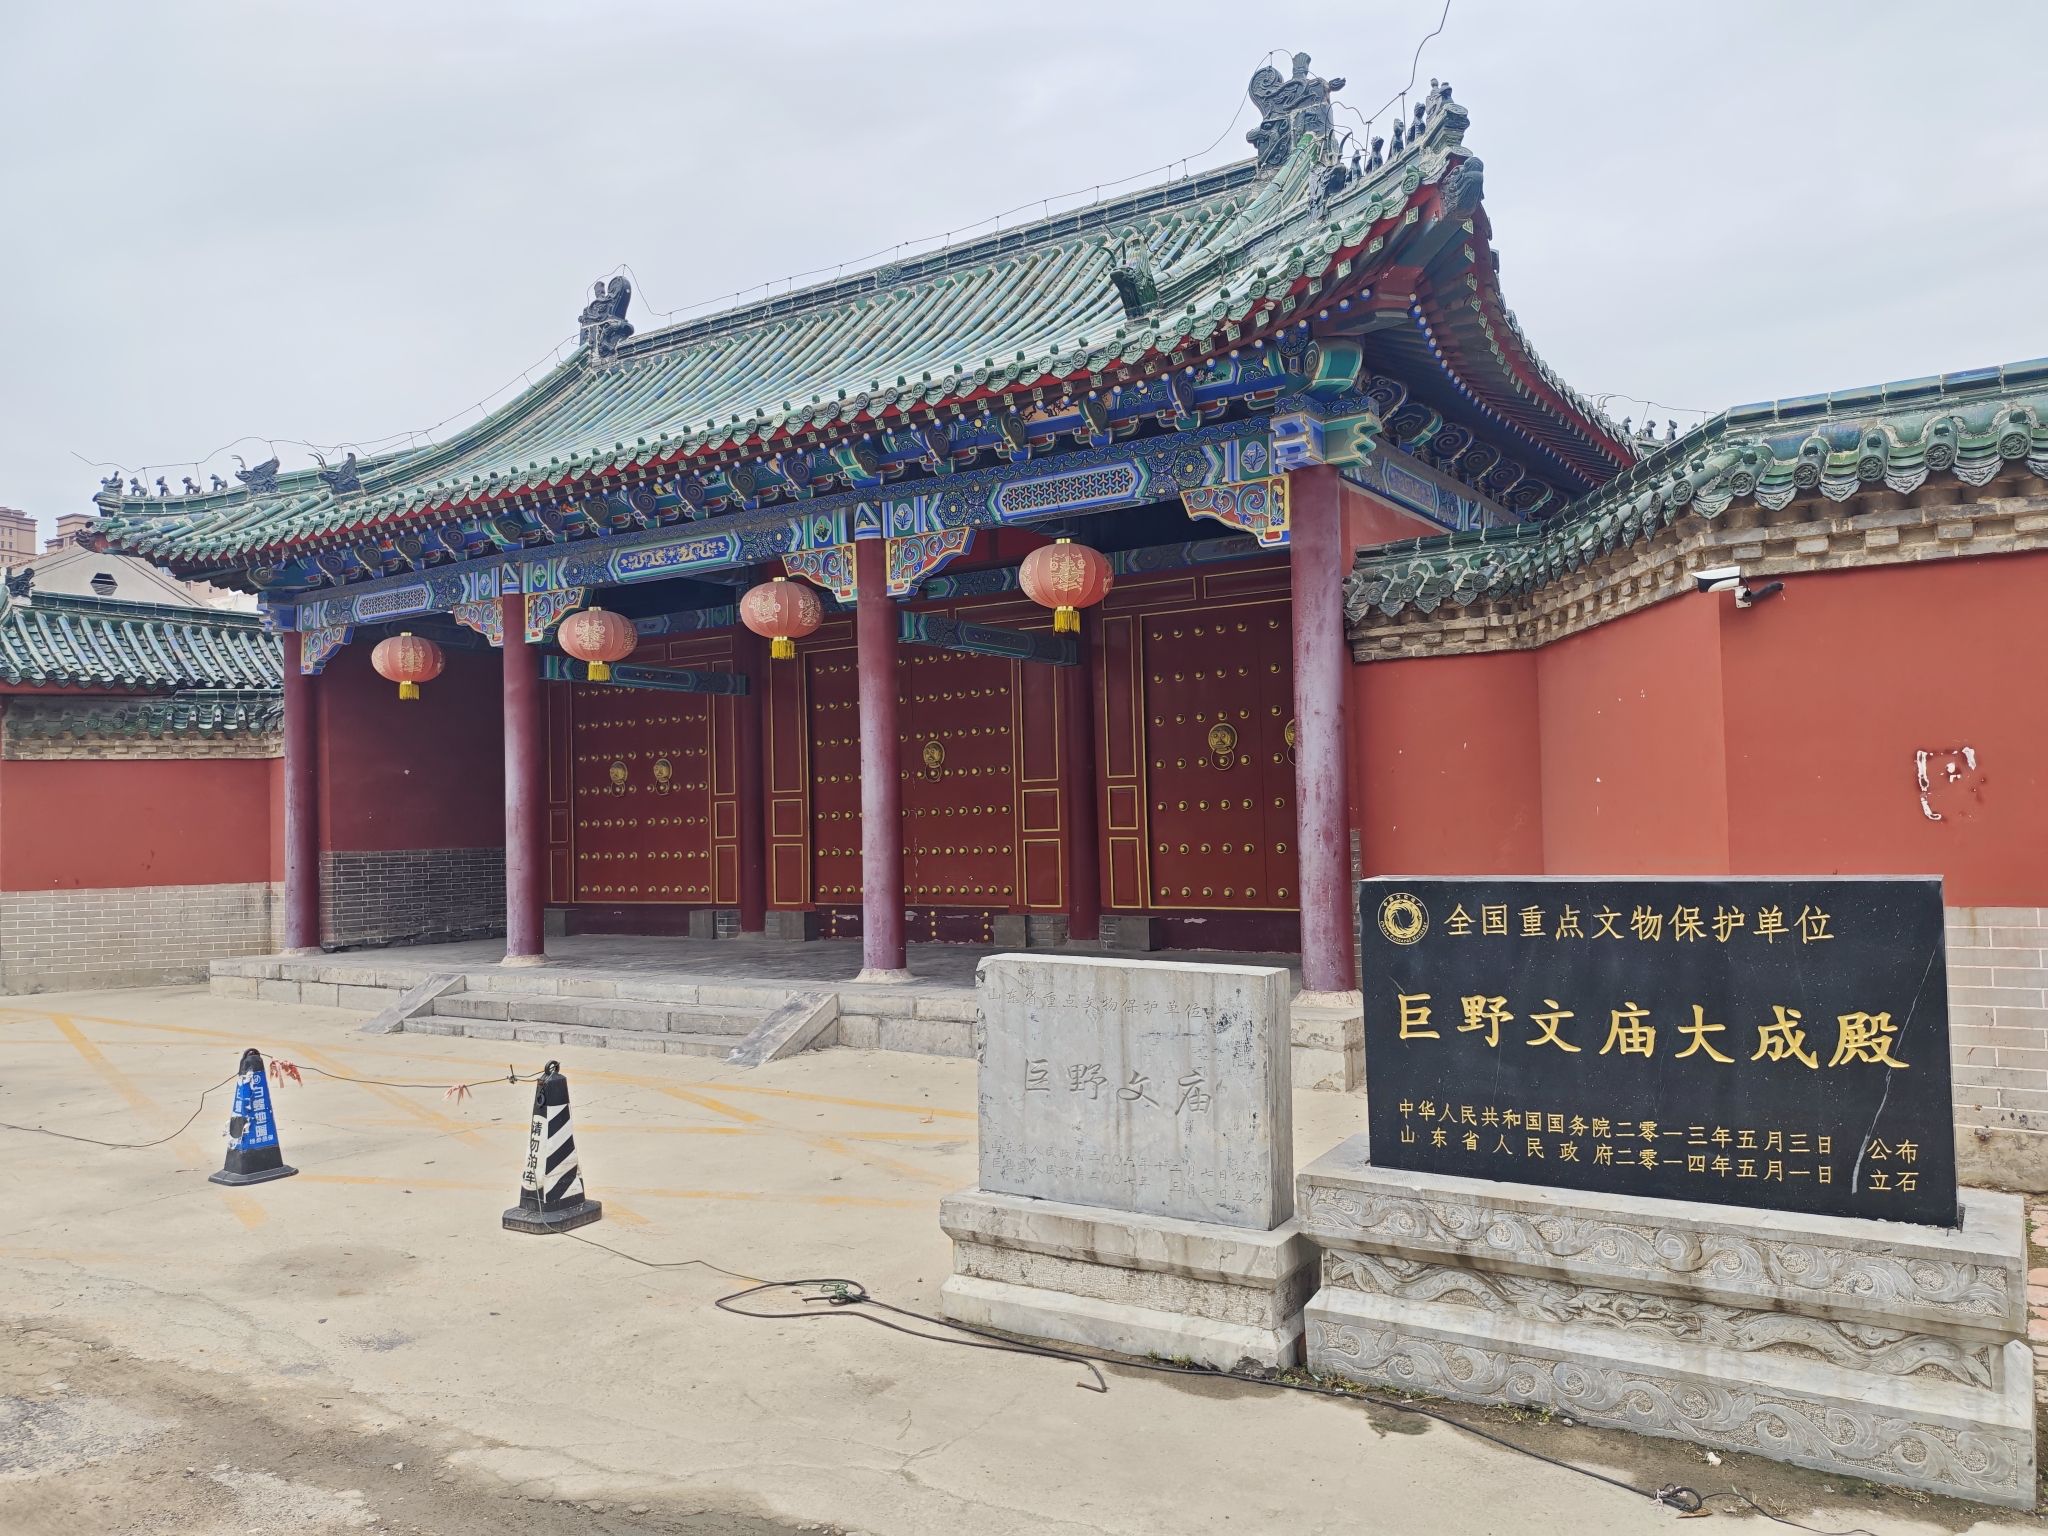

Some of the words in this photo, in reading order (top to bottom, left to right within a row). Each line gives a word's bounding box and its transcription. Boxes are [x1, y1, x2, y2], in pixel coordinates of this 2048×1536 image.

[1444, 904, 1835, 944] 全国重点文物保护单位
[988, 988, 1203, 1019] 山东省重点文物保护单位
[1397, 992, 1910, 1070] 巨野文庙大成殿
[1024, 1058, 1212, 1116] 巨野文庙
[522, 1121, 543, 1185] 请勿泊车
